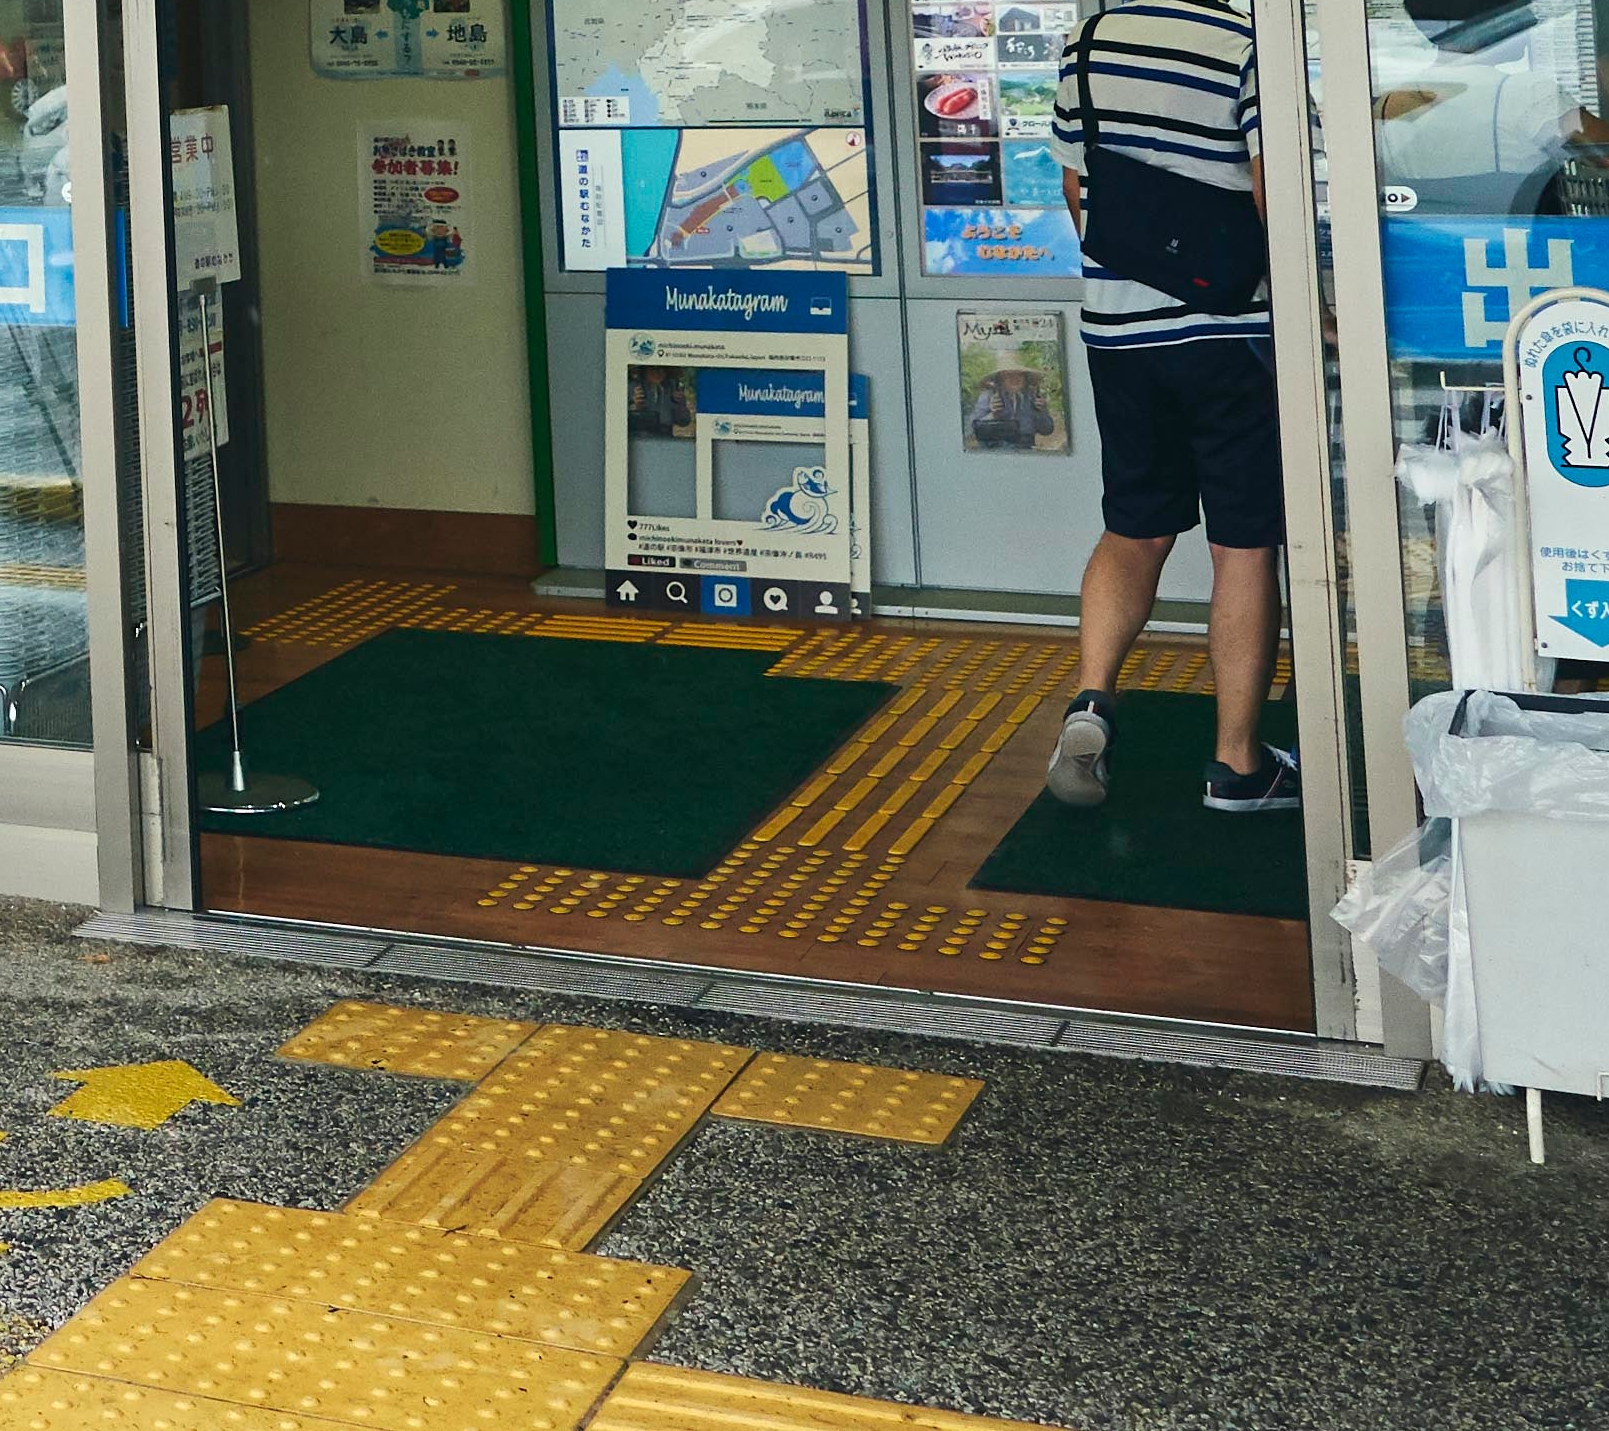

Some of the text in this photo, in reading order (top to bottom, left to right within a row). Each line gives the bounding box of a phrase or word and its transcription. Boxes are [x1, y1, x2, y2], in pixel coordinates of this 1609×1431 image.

[329, 24, 369, 45] 大島
[446, 23, 488, 44] 地島
[961, 224, 1023, 239] ようこそ
[976, 245, 1055, 261] むなかたへ
[665, 285, 789, 321] Munakatagram
[737, 383, 825, 410] Munakatagram
[641, 556, 740, 571] Liked Comment
